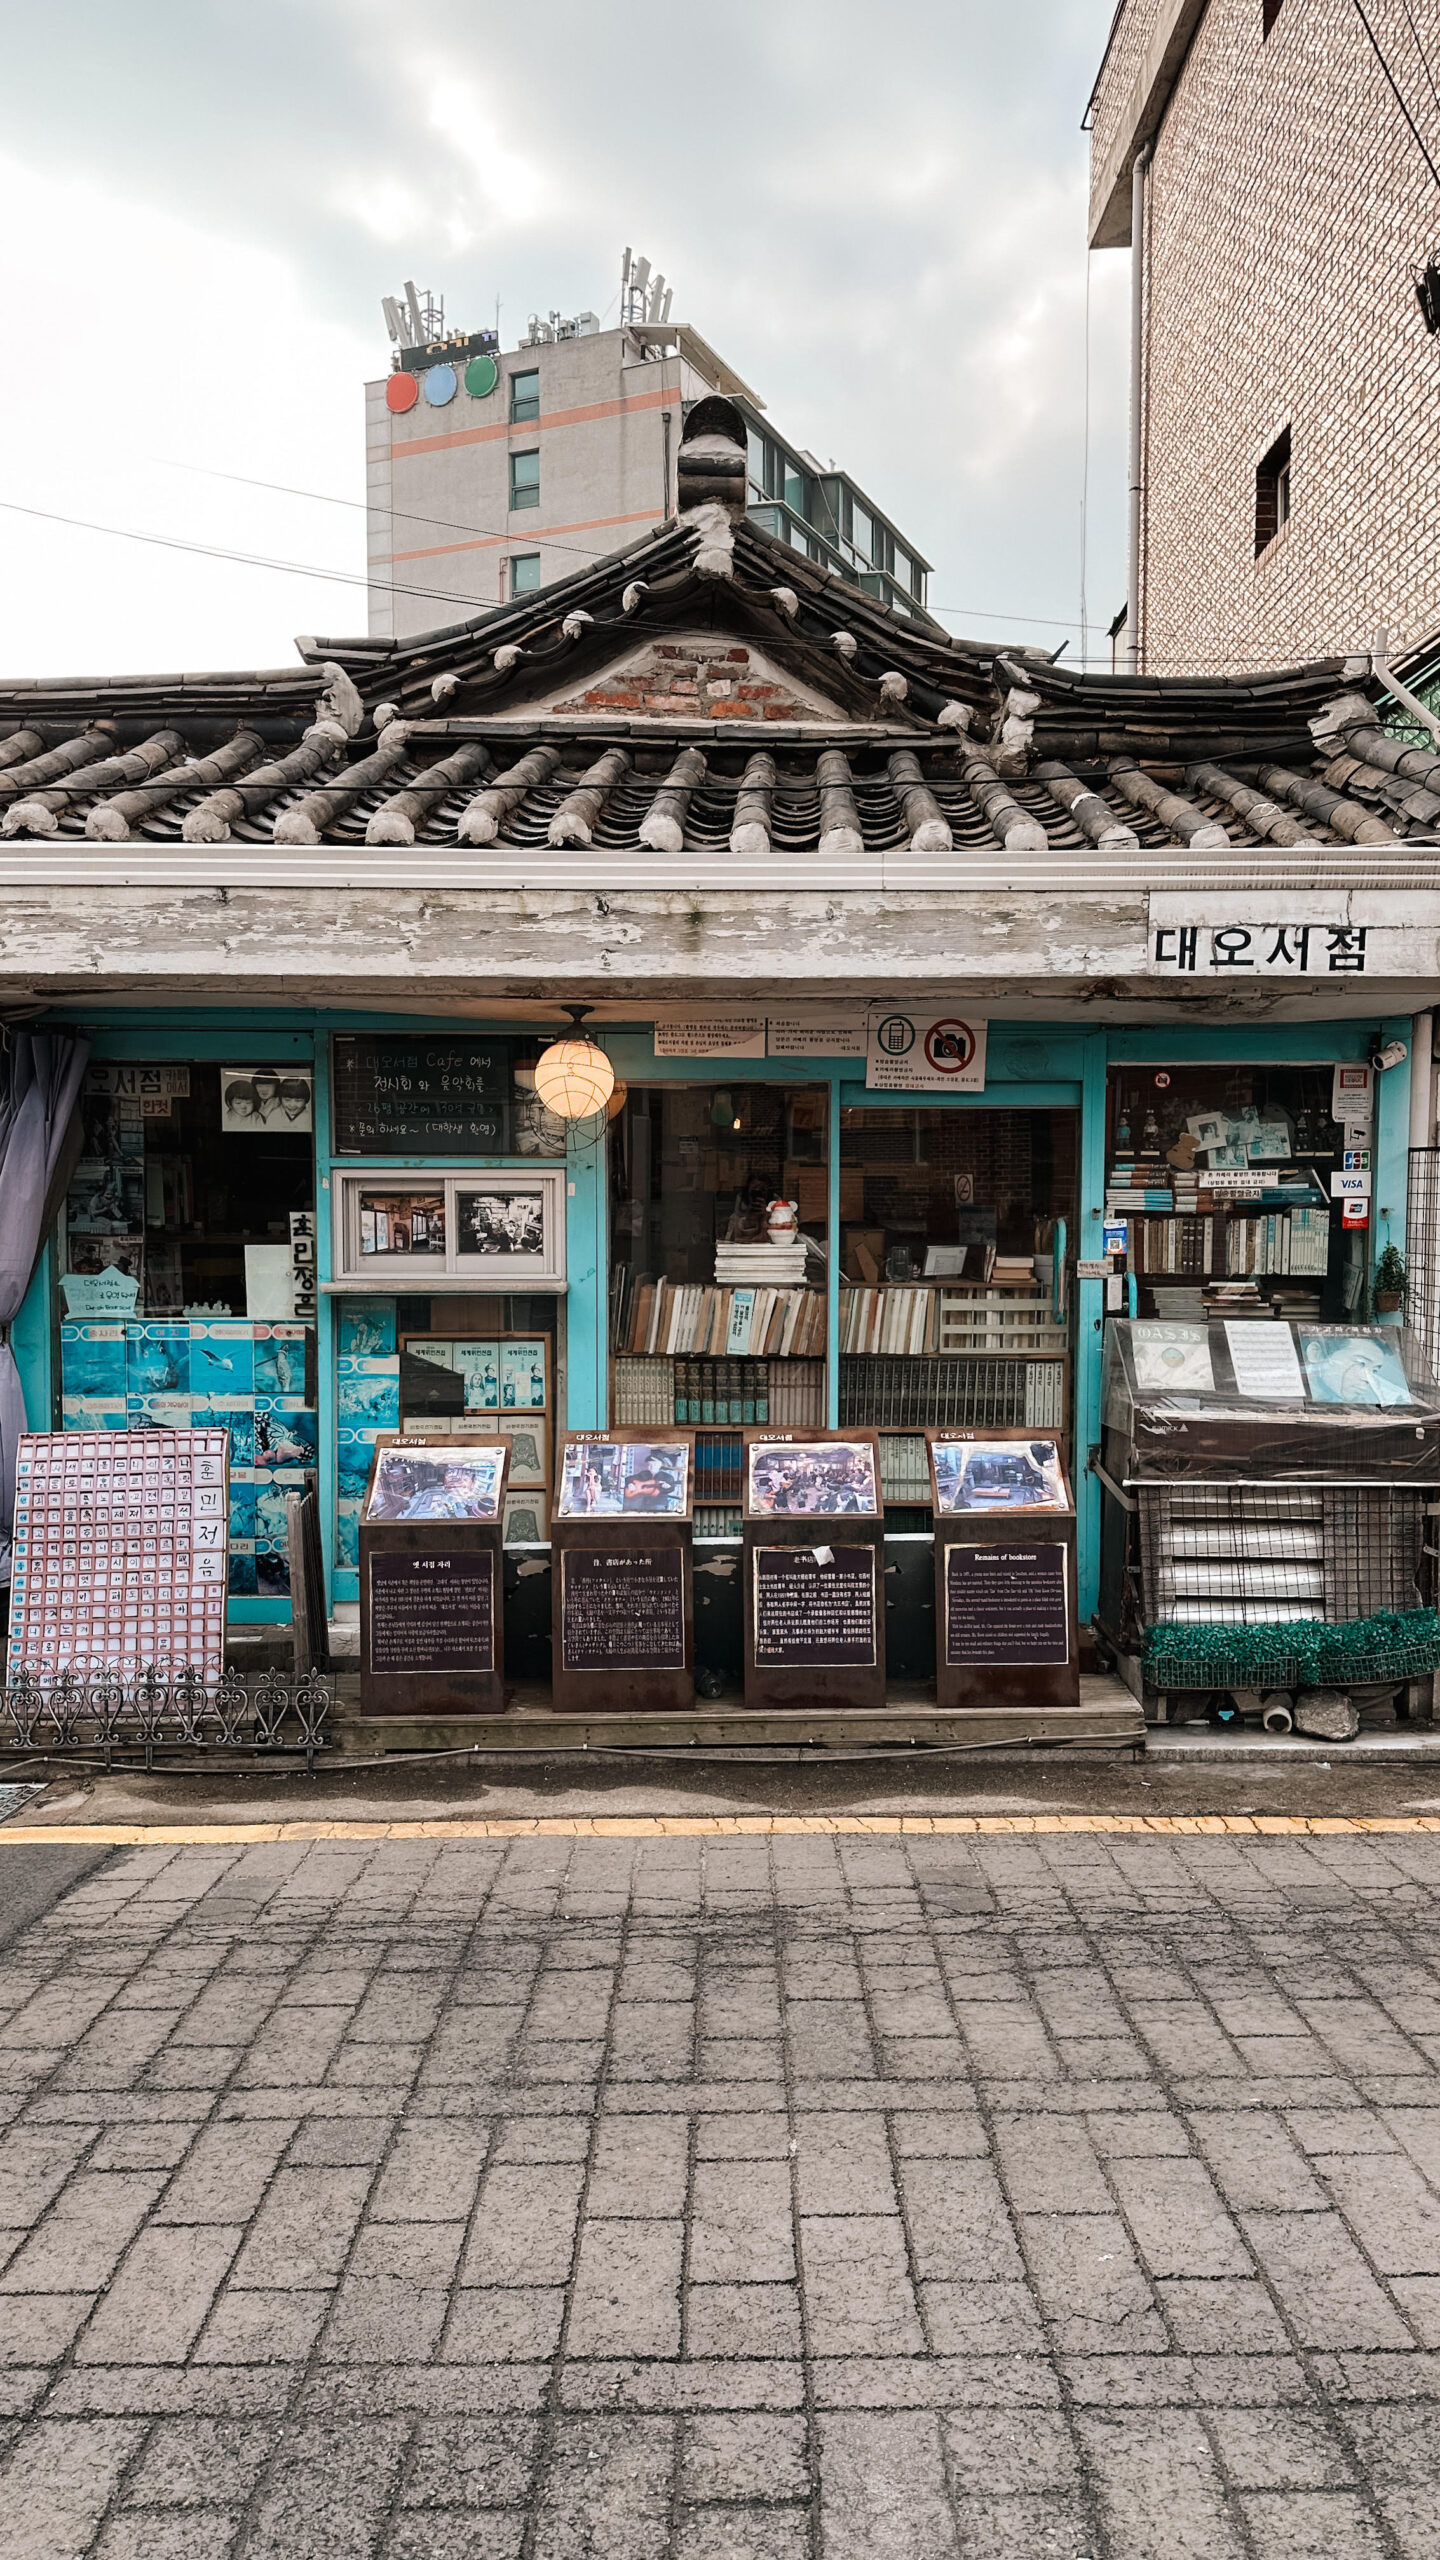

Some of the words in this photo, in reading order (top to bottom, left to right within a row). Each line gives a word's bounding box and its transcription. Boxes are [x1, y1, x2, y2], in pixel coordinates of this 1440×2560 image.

[1155, 926, 1367, 971] 대오서점
[426, 1049, 463, 1071] Cafe
[470, 1056, 491, 1068] 에서
[418, 1080, 430, 1091] 와
[1341, 1180, 1363, 1188] VISA
[576, 1434, 610, 1443] 대오서점
[760, 1433, 793, 1442] 대오서점
[941, 1432, 975, 1441] 대오서점
[392, 1437, 427, 1446] 대오서점
[974, 1553, 1000, 1562] Remains
[1000, 1553, 1007, 1562] of
[1008, 1552, 1037, 1562] bookstore
[412, 1560, 420, 1569] 옛
[422, 1560, 435, 1569] 서점
[437, 1560, 452, 1569] 자리
